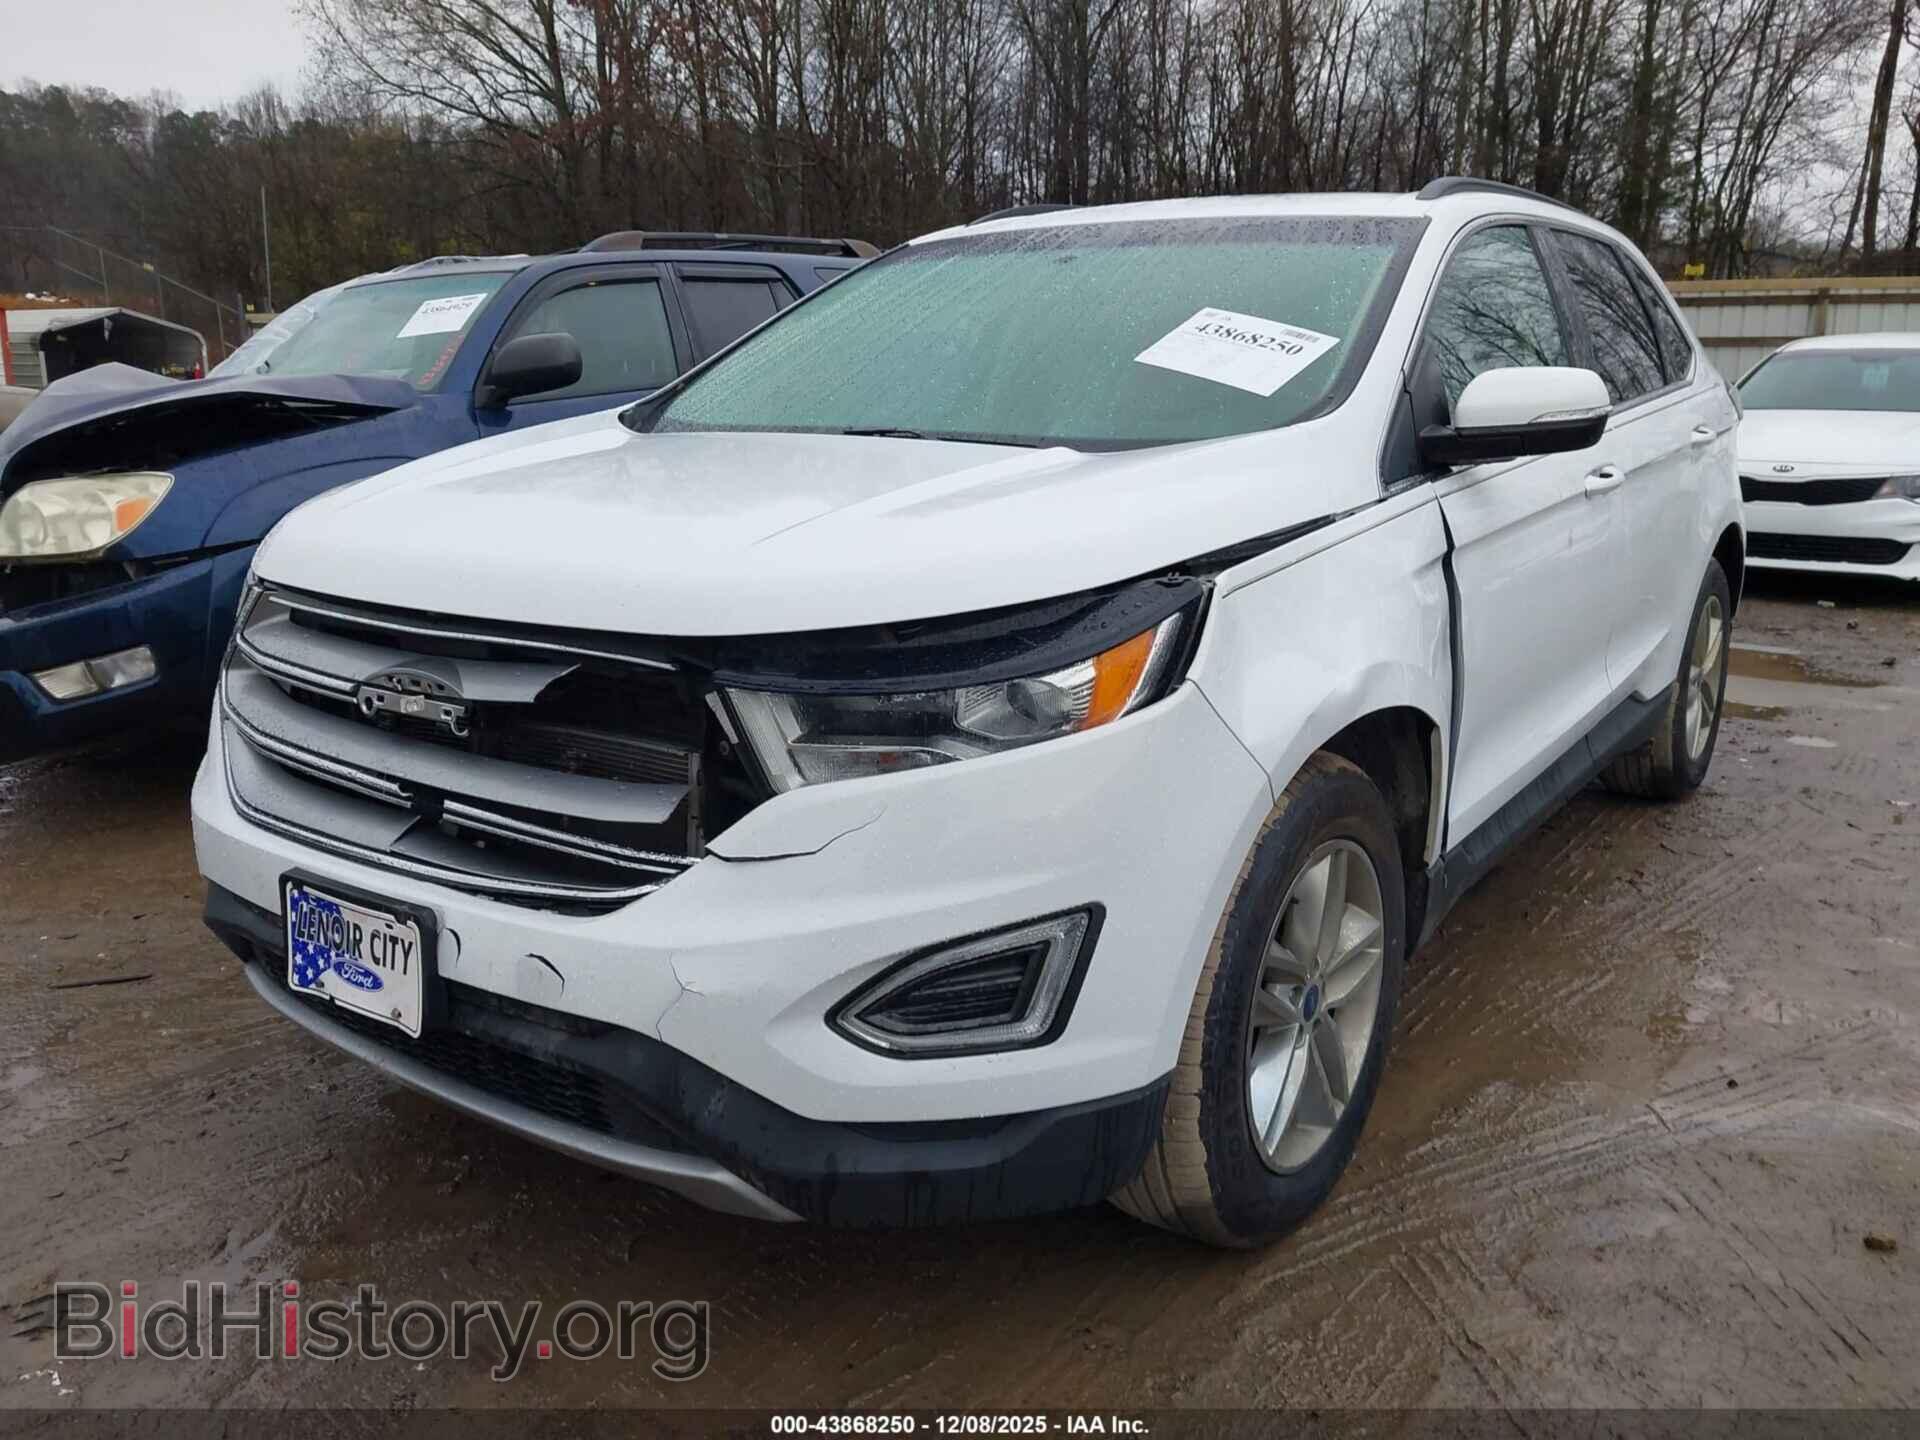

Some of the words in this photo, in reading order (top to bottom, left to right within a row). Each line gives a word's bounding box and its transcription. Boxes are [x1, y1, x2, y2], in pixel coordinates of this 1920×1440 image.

[1195, 321, 1304, 356] 43868250
[296, 902, 363, 959] LENOIR
[370, 929, 413, 975] CITY
[341, 963, 374, 988] Ford
